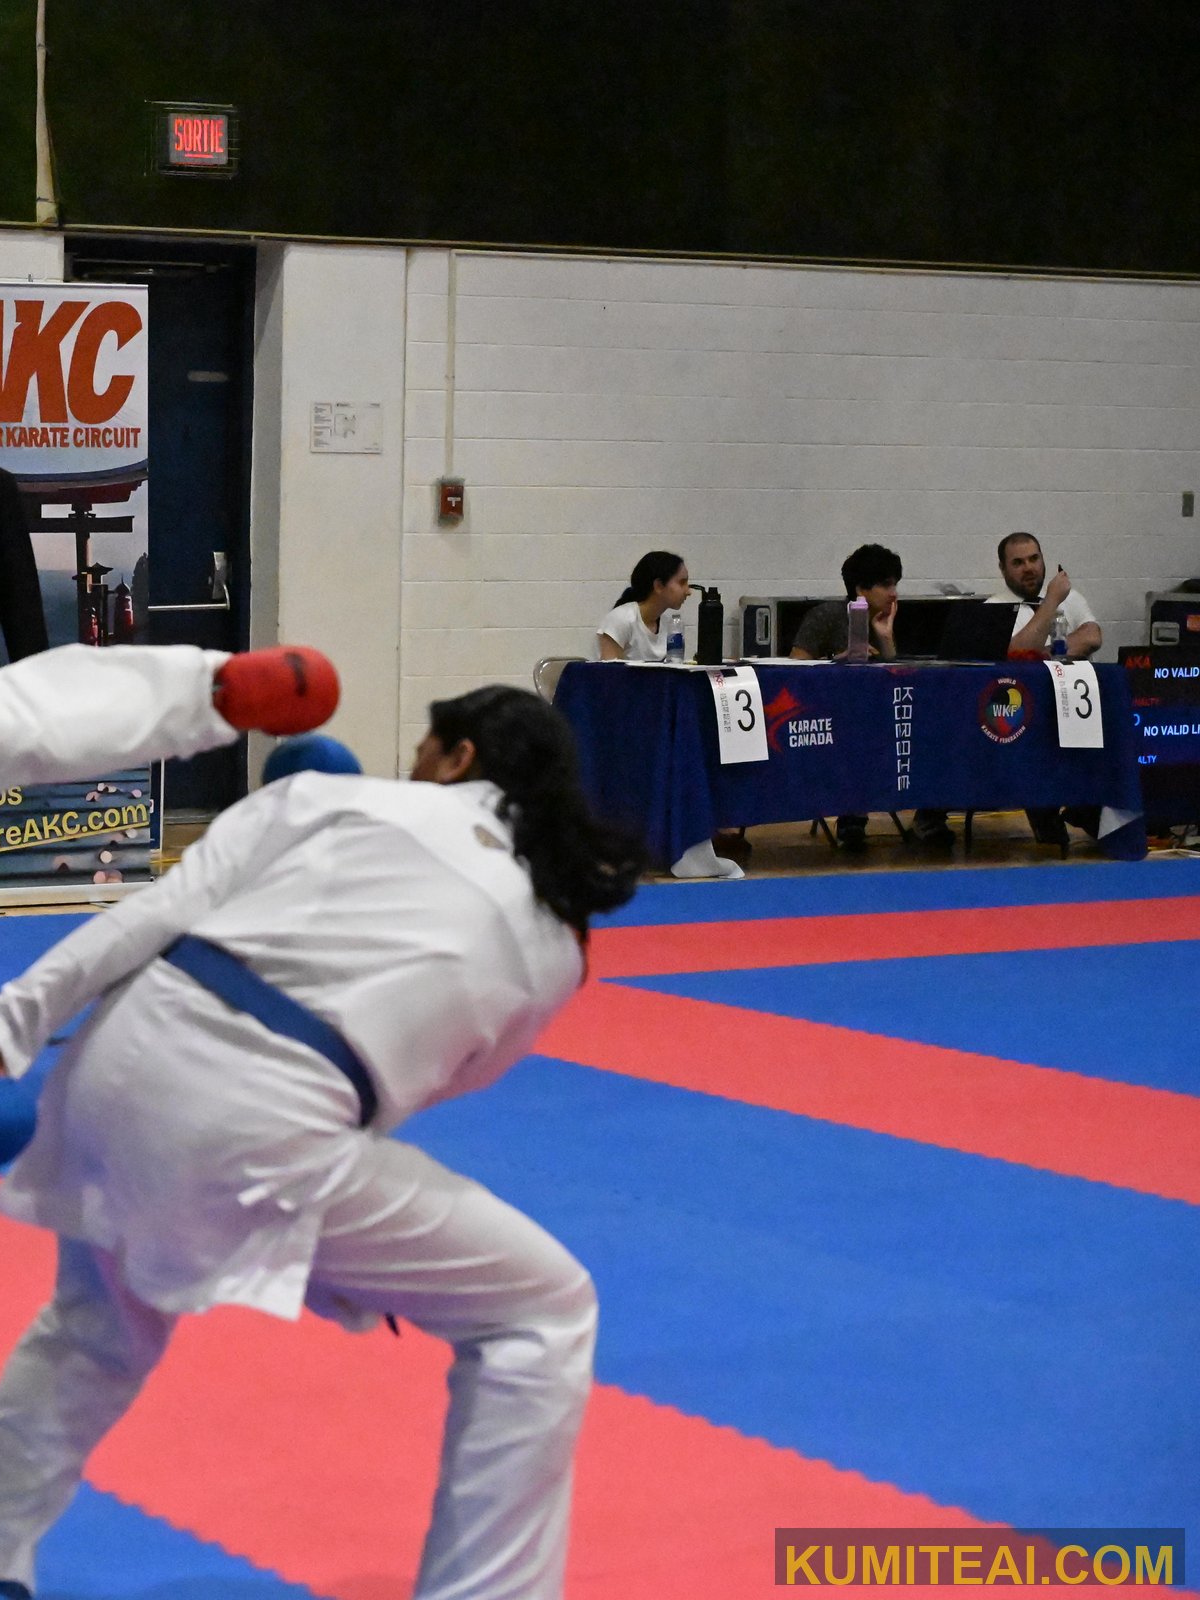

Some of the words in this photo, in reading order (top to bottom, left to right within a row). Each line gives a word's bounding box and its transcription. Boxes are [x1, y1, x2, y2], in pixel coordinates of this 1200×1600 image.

[174, 119, 224, 153] SORTIE
[6, 427, 69, 448] KARATE
[73, 427, 141, 448] CIRCUIT
[1154, 668, 1169, 678] NO
[1171, 667, 1200, 678] VALID
[1073, 679, 1093, 719] 3
[735, 689, 756, 732] 3
[992, 704, 1018, 717] WKF
[788, 718, 832, 734] KARATE
[1143, 726, 1159, 737] NO
[1161, 724, 1189, 736] VALID
[789, 732, 834, 748] CANADA
